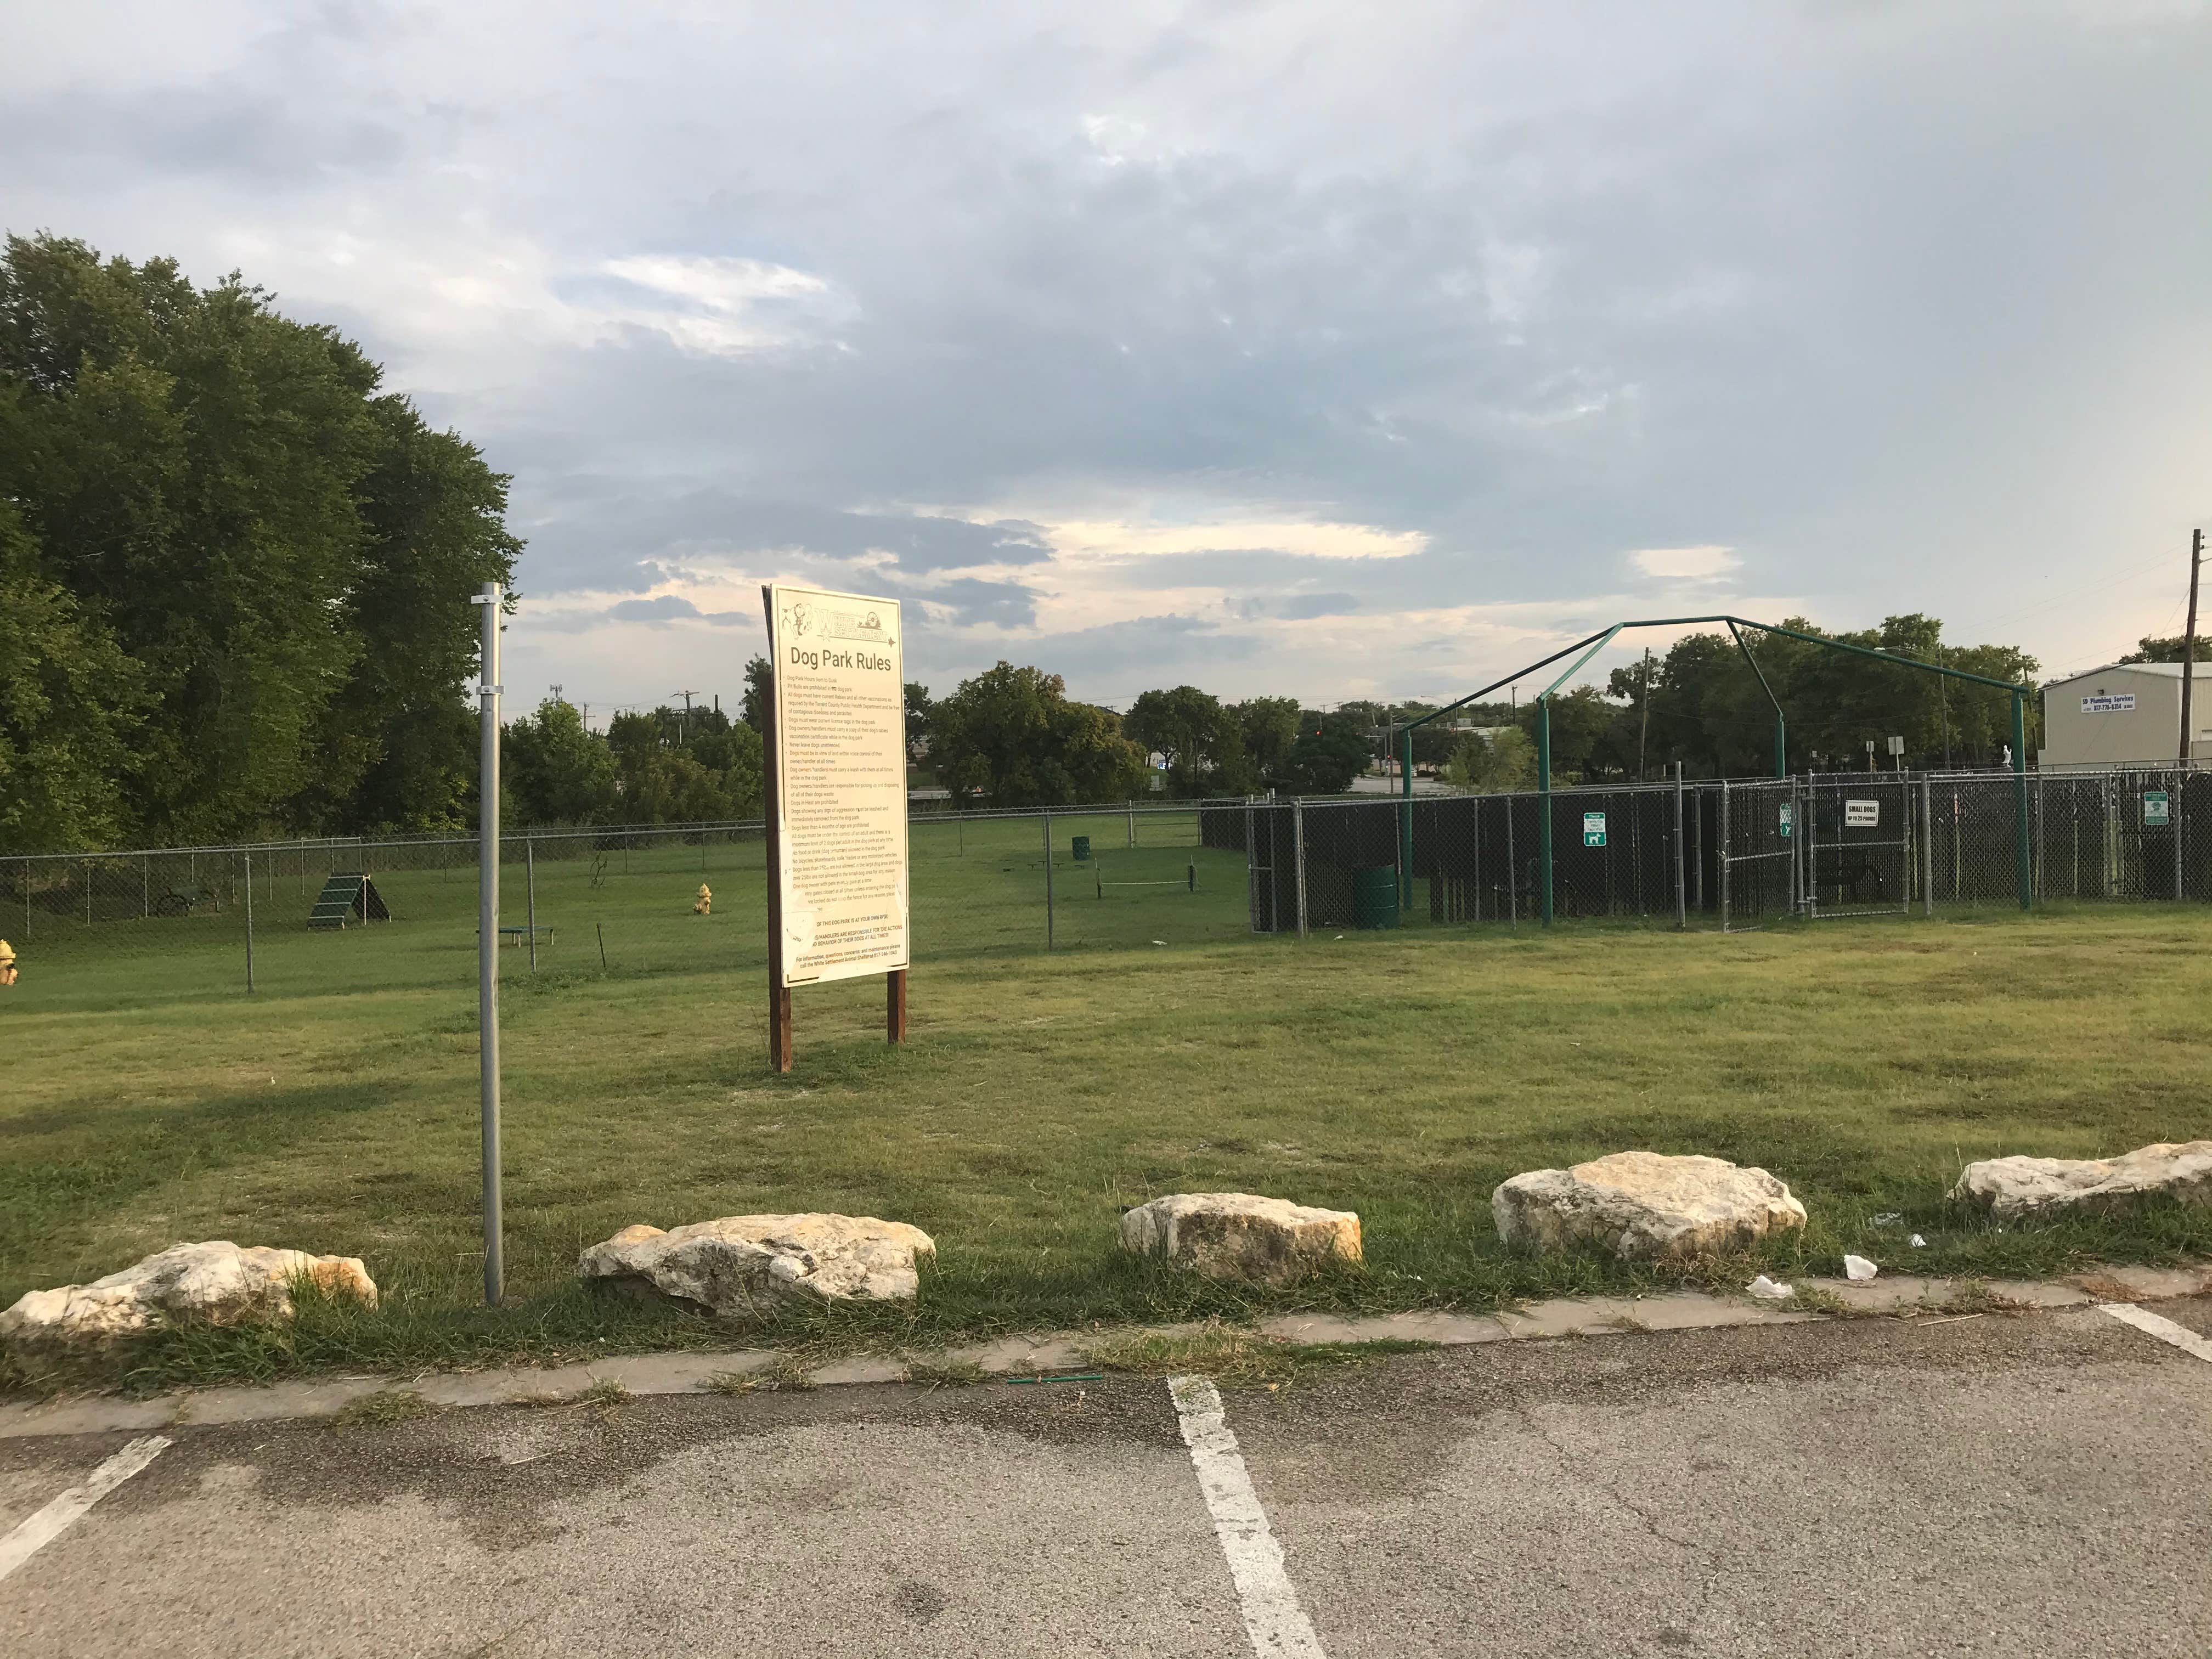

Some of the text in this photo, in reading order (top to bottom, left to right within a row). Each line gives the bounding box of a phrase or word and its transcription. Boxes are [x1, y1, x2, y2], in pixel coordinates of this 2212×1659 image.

[834, 627, 887, 641] SETTLEMENT
[791, 646, 891, 671] Dog Park Rules
